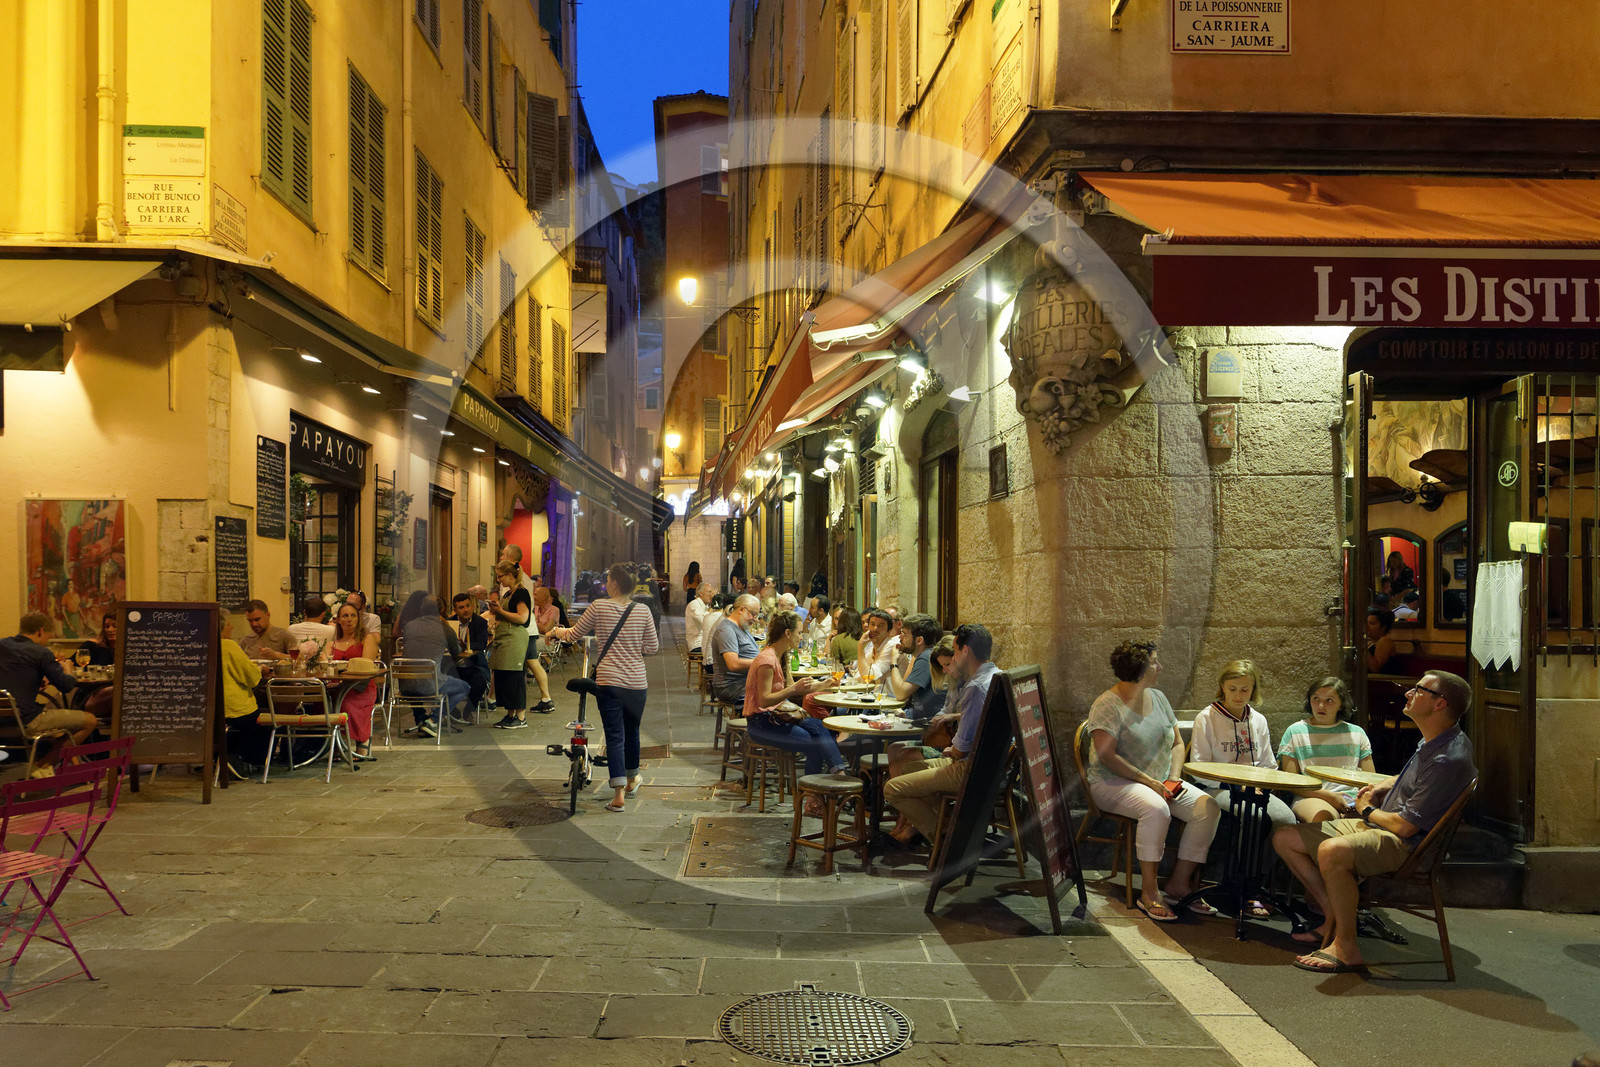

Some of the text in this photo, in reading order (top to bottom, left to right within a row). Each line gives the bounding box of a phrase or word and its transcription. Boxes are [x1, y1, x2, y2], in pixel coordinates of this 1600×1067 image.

[1180, 1, 1283, 13] DE LA POISSONNERIE
[1192, 20, 1270, 32] CARRIERA
[1187, 34, 1215, 46] SAN
[1231, 35, 1275, 48] JAUME
[154, 183, 174, 191] RUE
[164, 193, 201, 201] BUNICO
[137, 205, 191, 213] CARRIERA
[159, 215, 188, 223] L'ARC
[1037, 284, 1067, 306] LES
[1313, 265, 1600, 323] LES DISTI
[1377, 340, 1468, 359] COMPTOIR
[1472, 340, 1491, 359] ET
[1495, 340, 1550, 360] SALON
[1555, 341, 1574, 360] DE
[463, 392, 500, 433] PAPAYOU
[290, 420, 364, 469] PAPAYOU
